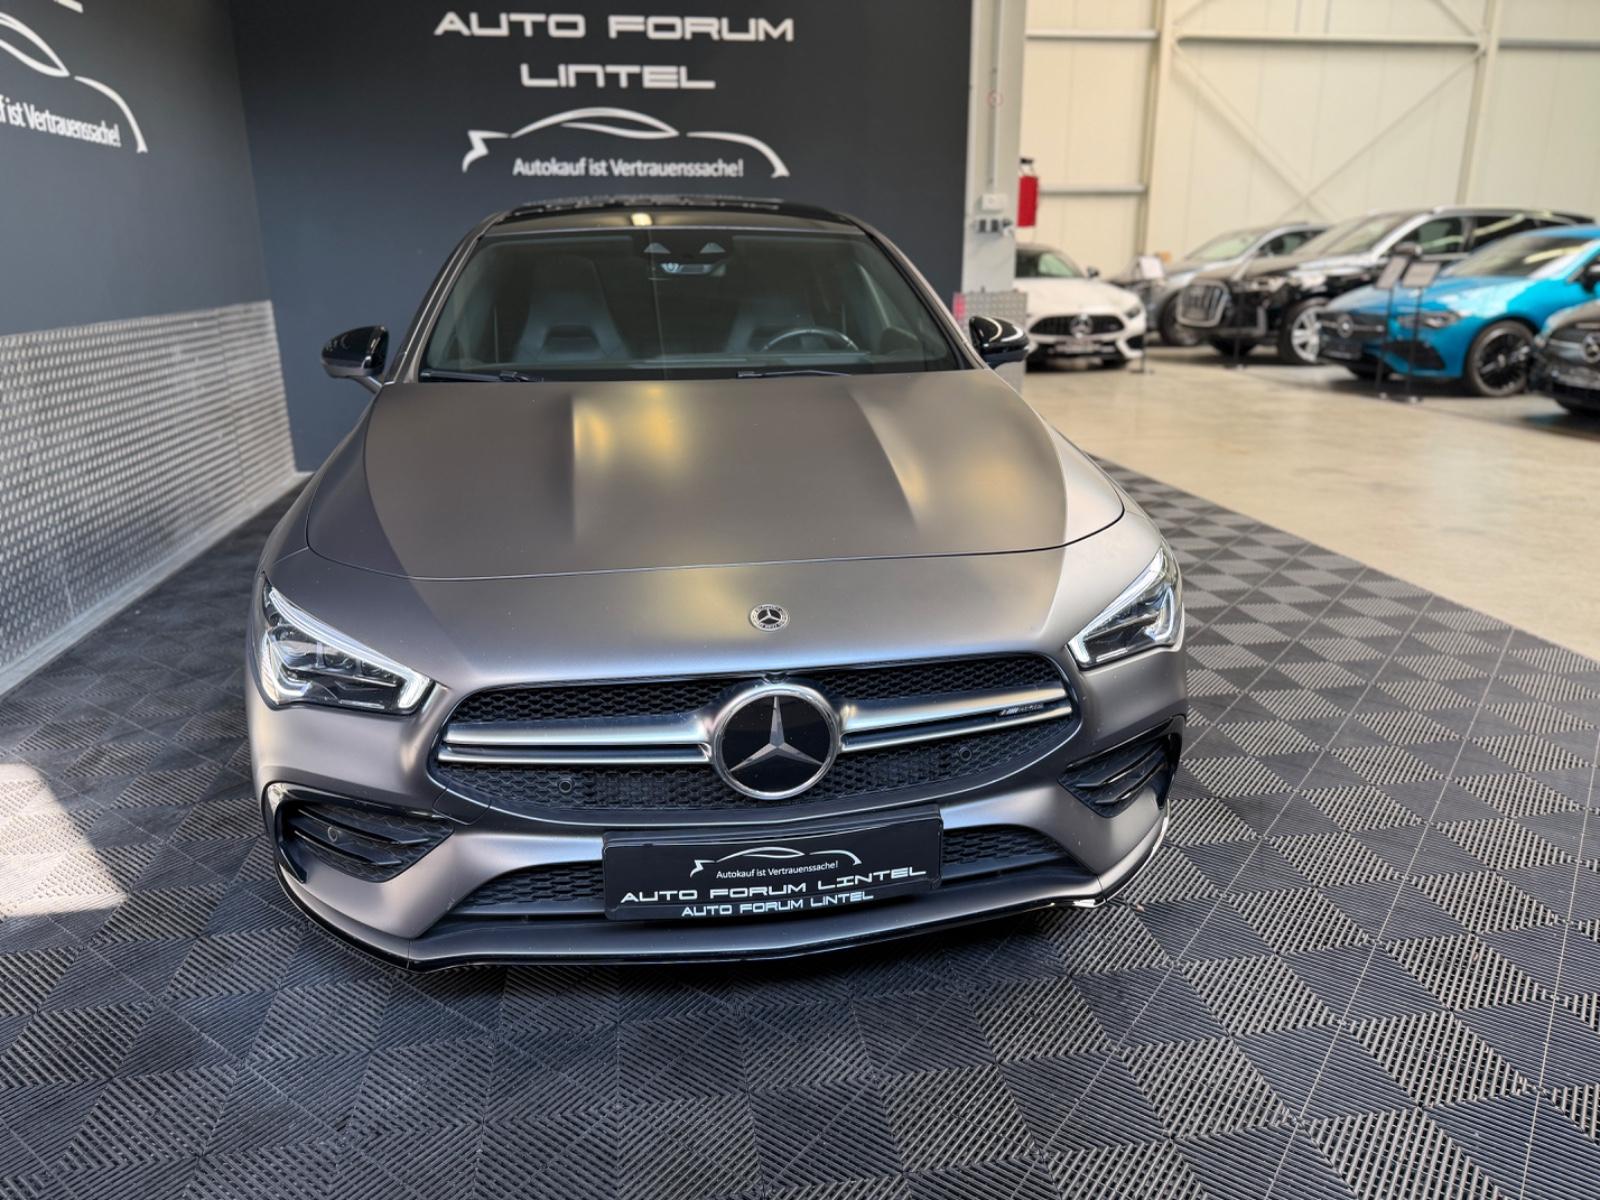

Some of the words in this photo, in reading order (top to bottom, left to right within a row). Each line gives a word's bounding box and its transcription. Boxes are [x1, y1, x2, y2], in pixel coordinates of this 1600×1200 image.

[434, 12, 586, 38] AUTO
[607, 15, 794, 42] FORUM
[520, 63, 716, 89] LINTEL
[6, 97, 26, 127] ist
[512, 157, 587, 177] Autokauf
[589, 159, 609, 177] ist
[609, 159, 744, 178] Vertrauenssache!
[716, 868, 756, 879] Autokauf
[756, 868, 766, 877] ist
[767, 860, 839, 876] Vertrauenssache!
[620, 889, 698, 904] AUTO
[710, 882, 807, 899] FORUM
[817, 866, 927, 890] LINTEL
[681, 904, 733, 917] AUTO
[739, 899, 804, 914] FORUM
[810, 891, 874, 907] LINTEL
